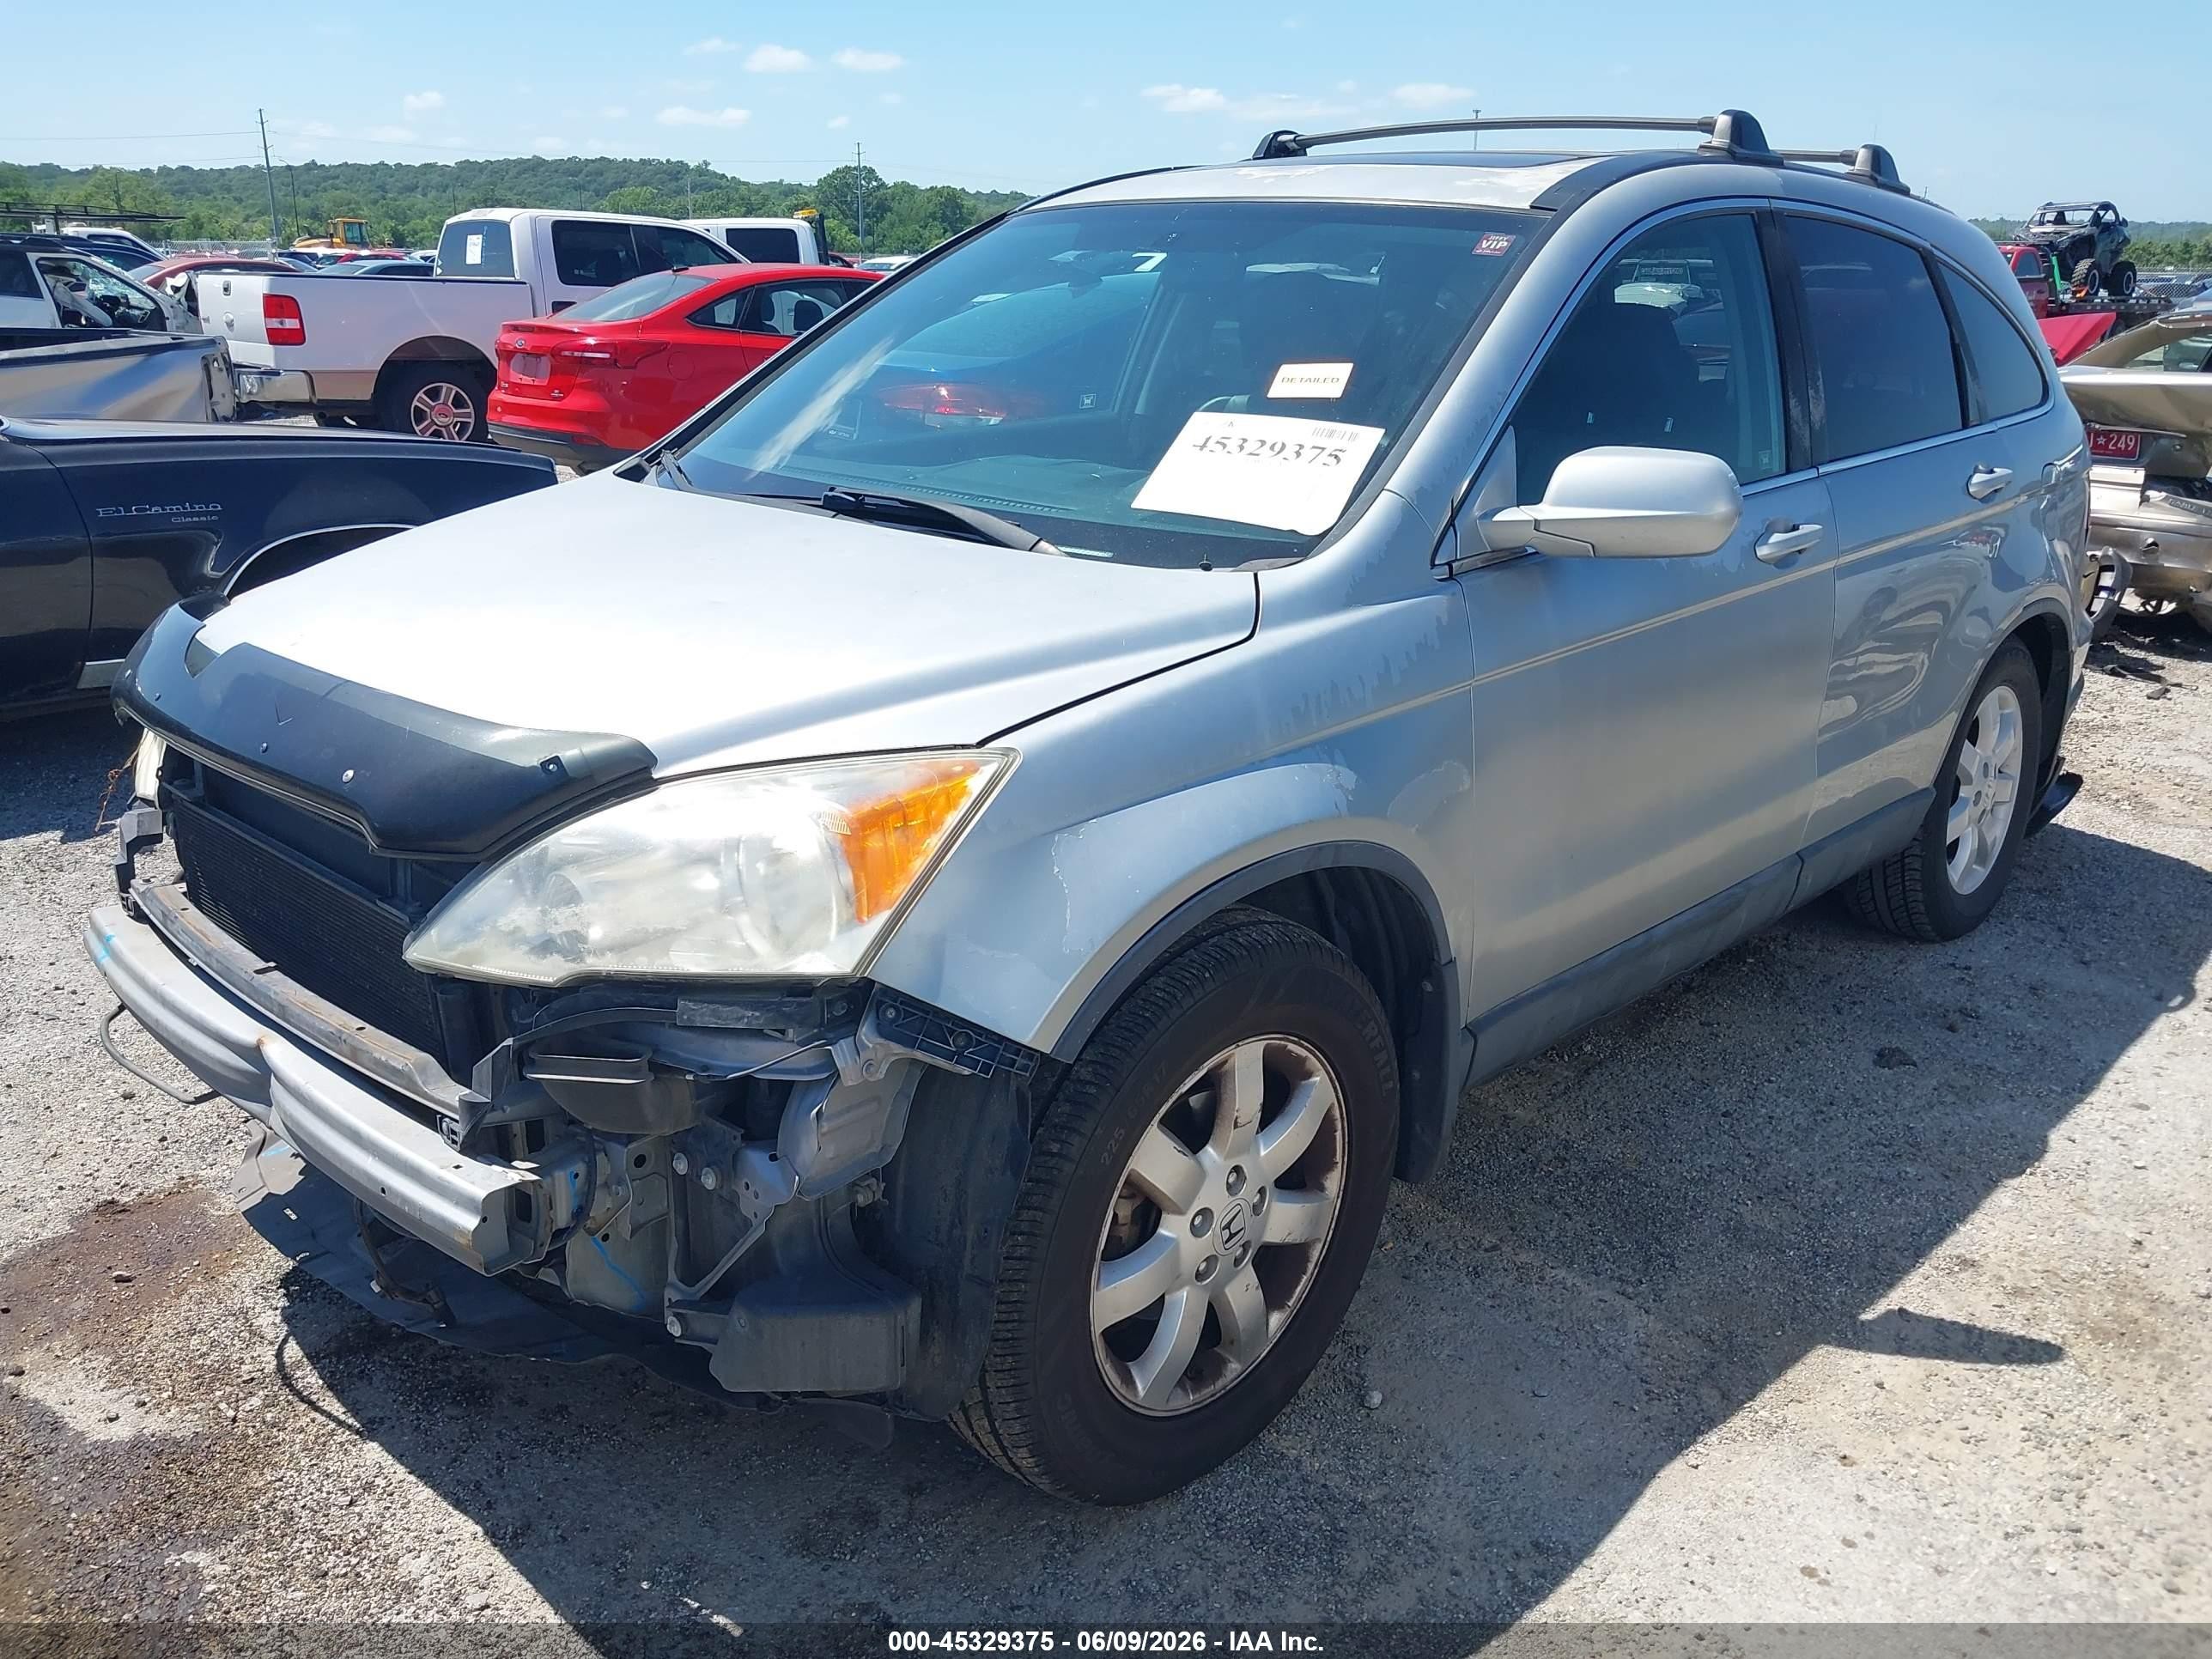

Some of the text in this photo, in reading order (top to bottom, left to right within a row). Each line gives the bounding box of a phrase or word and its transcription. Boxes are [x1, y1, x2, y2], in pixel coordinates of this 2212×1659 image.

[1481, 240, 1508, 249] VIP
[1192, 434, 1347, 467] 45329375
[2108, 433, 2135, 451] 249
